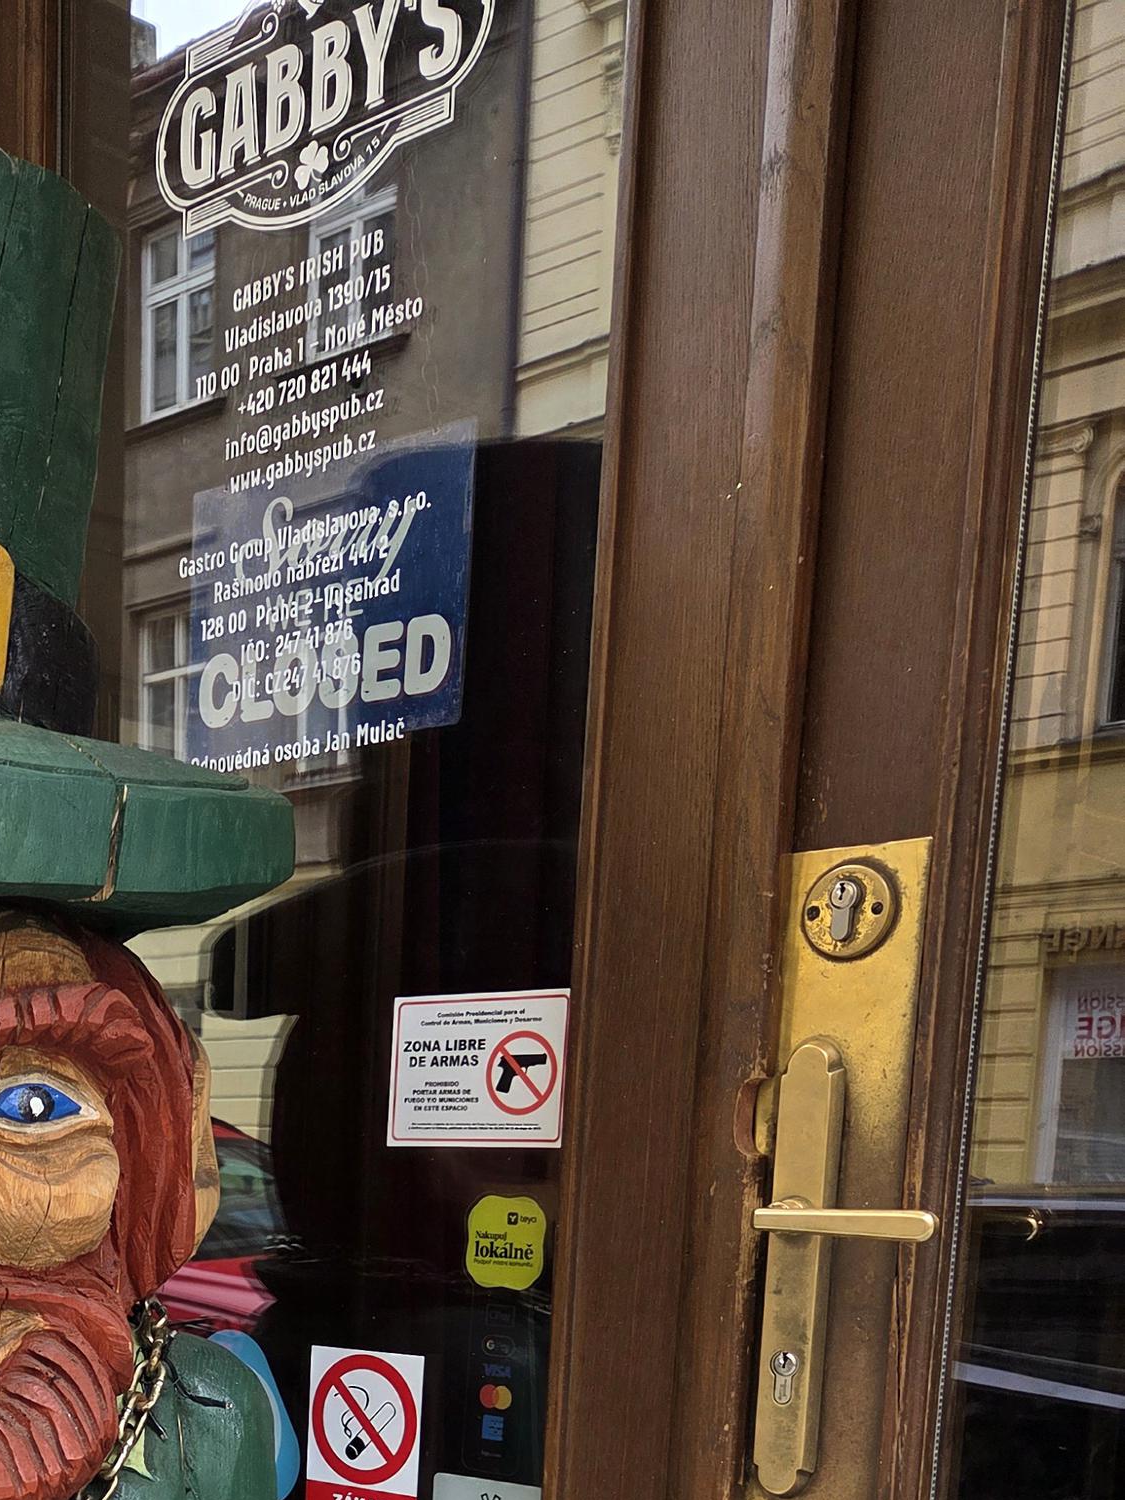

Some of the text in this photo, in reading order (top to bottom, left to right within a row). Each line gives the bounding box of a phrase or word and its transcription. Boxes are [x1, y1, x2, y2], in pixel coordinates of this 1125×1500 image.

[243, 193, 282, 211] PRAGUE
[364, 135, 381, 155] 15
[233, 228, 385, 313] GABBY'S IRISH PUB
[224, 264, 391, 353] Vladislavova 1390/15
[195, 374, 217, 400] 110
[221, 363, 240, 390] 00
[249, 347, 292, 381] Praha
[297, 337, 305, 362] 1
[325, 313, 366, 352] Nové
[371, 296, 423, 335] Město
[237, 350, 372, 417] +420 720 821 444
[224, 388, 385, 461] info@gabbyspub.cz
[229, 429, 376, 494] www.gabbyspub.cz
[178, 490, 432, 579] Gastro Group Vladislavova, s.r.o.
[213, 534, 389, 605] Rašínovo nábřeží 44/2
[200, 615, 225, 642] 128
[228, 609, 247, 634] 00
[256, 597, 299, 628] Praha
[240, 617, 354, 667] IČO: 247 41 876
[198, 613, 452, 729] CLOSED
[232, 676, 261, 703] DIČ:
[312, 660, 326, 684] 41
[332, 652, 361, 680] 876
[275, 735, 320, 763] osoba
[324, 729, 350, 754] Jan
[356, 717, 405, 748] Mulač
[420, 1019, 442, 1027] Control
[474, 1017, 508, 1025] Municiones
[465, 1009, 503, 1018] Presidencial
[403, 1038, 487, 1053] ZONA LIBRE
[409, 1054, 479, 1068] DE ARMAS
[462, 1088, 472, 1096] DE
[475, 1241, 534, 1261] lokálně
